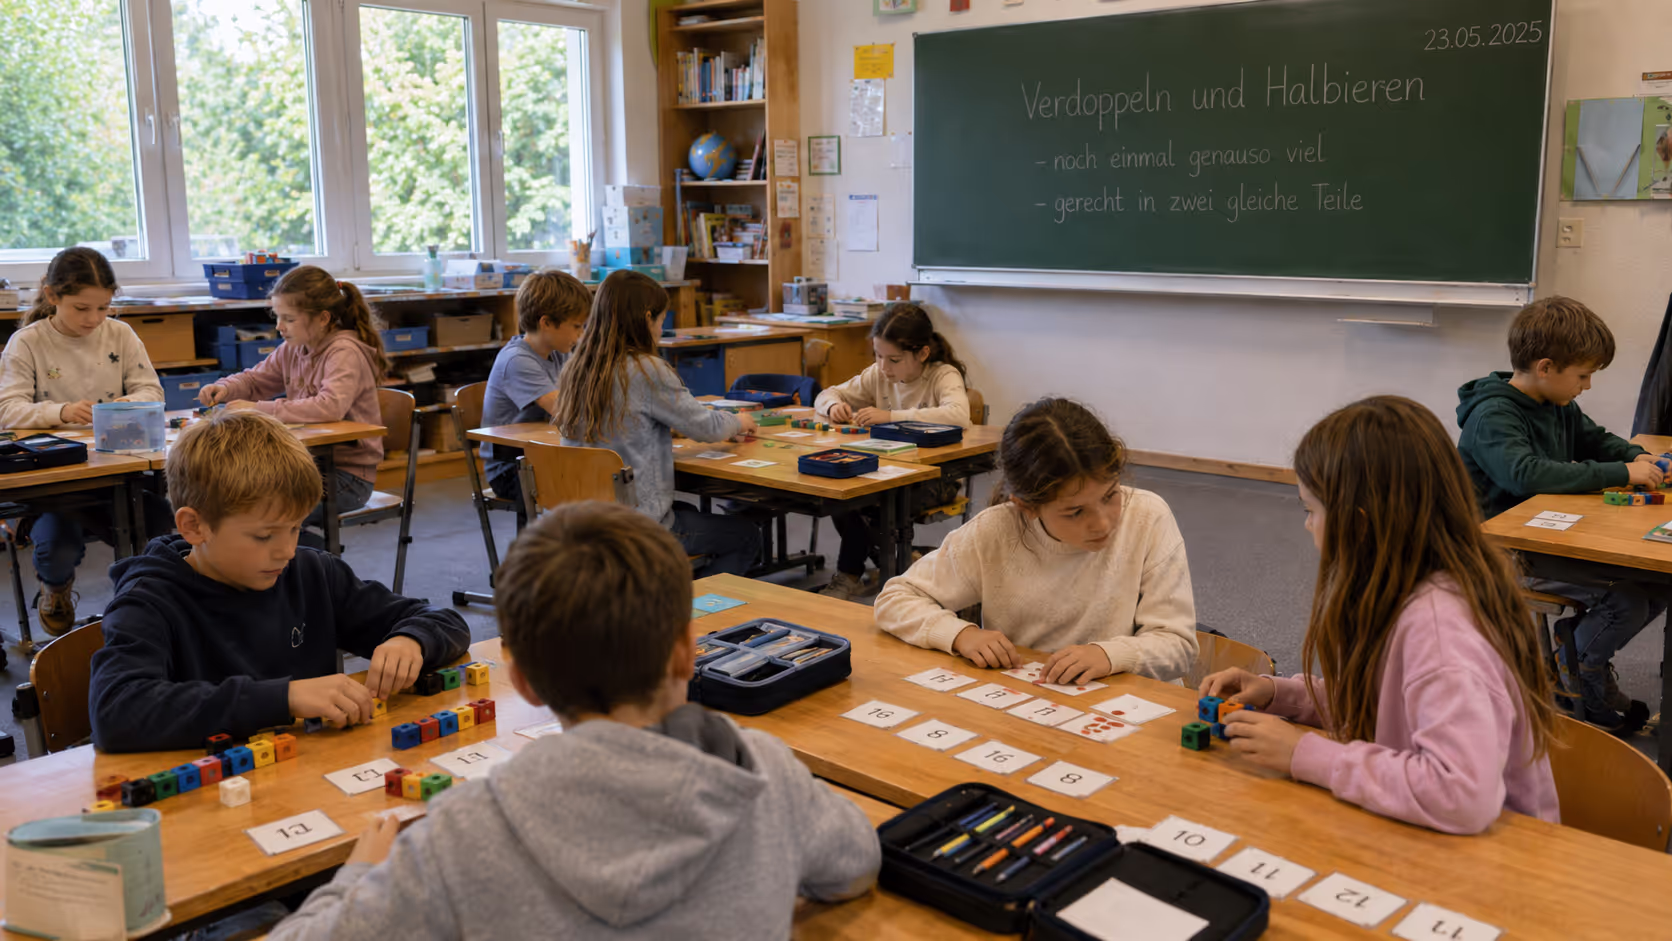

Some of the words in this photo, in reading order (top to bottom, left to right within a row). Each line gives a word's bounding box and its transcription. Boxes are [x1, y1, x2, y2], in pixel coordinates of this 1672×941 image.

[1424, 19, 1543, 51] 23.05.2025
[1021, 71, 1172, 132] Verdoppeln
[1192, 66, 1245, 110] und
[1266, 62, 1426, 107] Halbieren
[1054, 142, 1097, 170] noch
[1110, 139, 1176, 168] einmal
[1188, 148, 1271, 178] genauso
[1286, 133, 1325, 163] viel
[1054, 186, 1125, 224] gerecht
[1138, 189, 1156, 212] in
[1169, 188, 1214, 212] zwei
[1227, 181, 1299, 223] gleiche
[1311, 180, 1364, 211] Teile
[926, 728, 949, 740] 8
[984, 749, 1014, 764] 16
[1060, 772, 1084, 786] 8
[1173, 829, 1207, 847] 10
